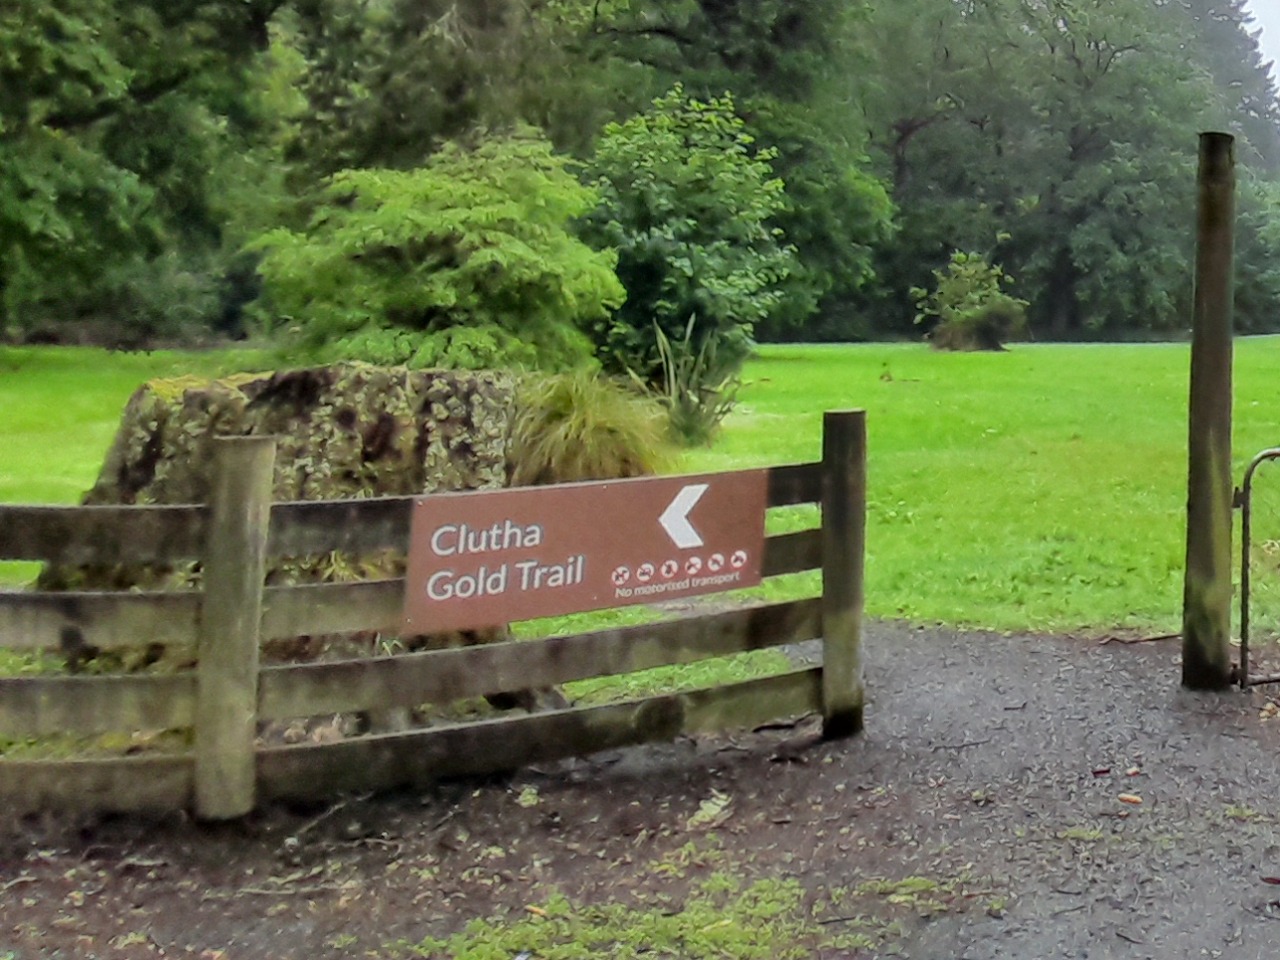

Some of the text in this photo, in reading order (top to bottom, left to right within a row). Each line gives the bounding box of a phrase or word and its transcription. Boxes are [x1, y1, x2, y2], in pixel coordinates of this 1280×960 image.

[430, 519, 542, 557] Clutha
[426, 554, 585, 601] Gold Trail
[615, 587, 632, 599] No
[691, 571, 741, 587] transport
